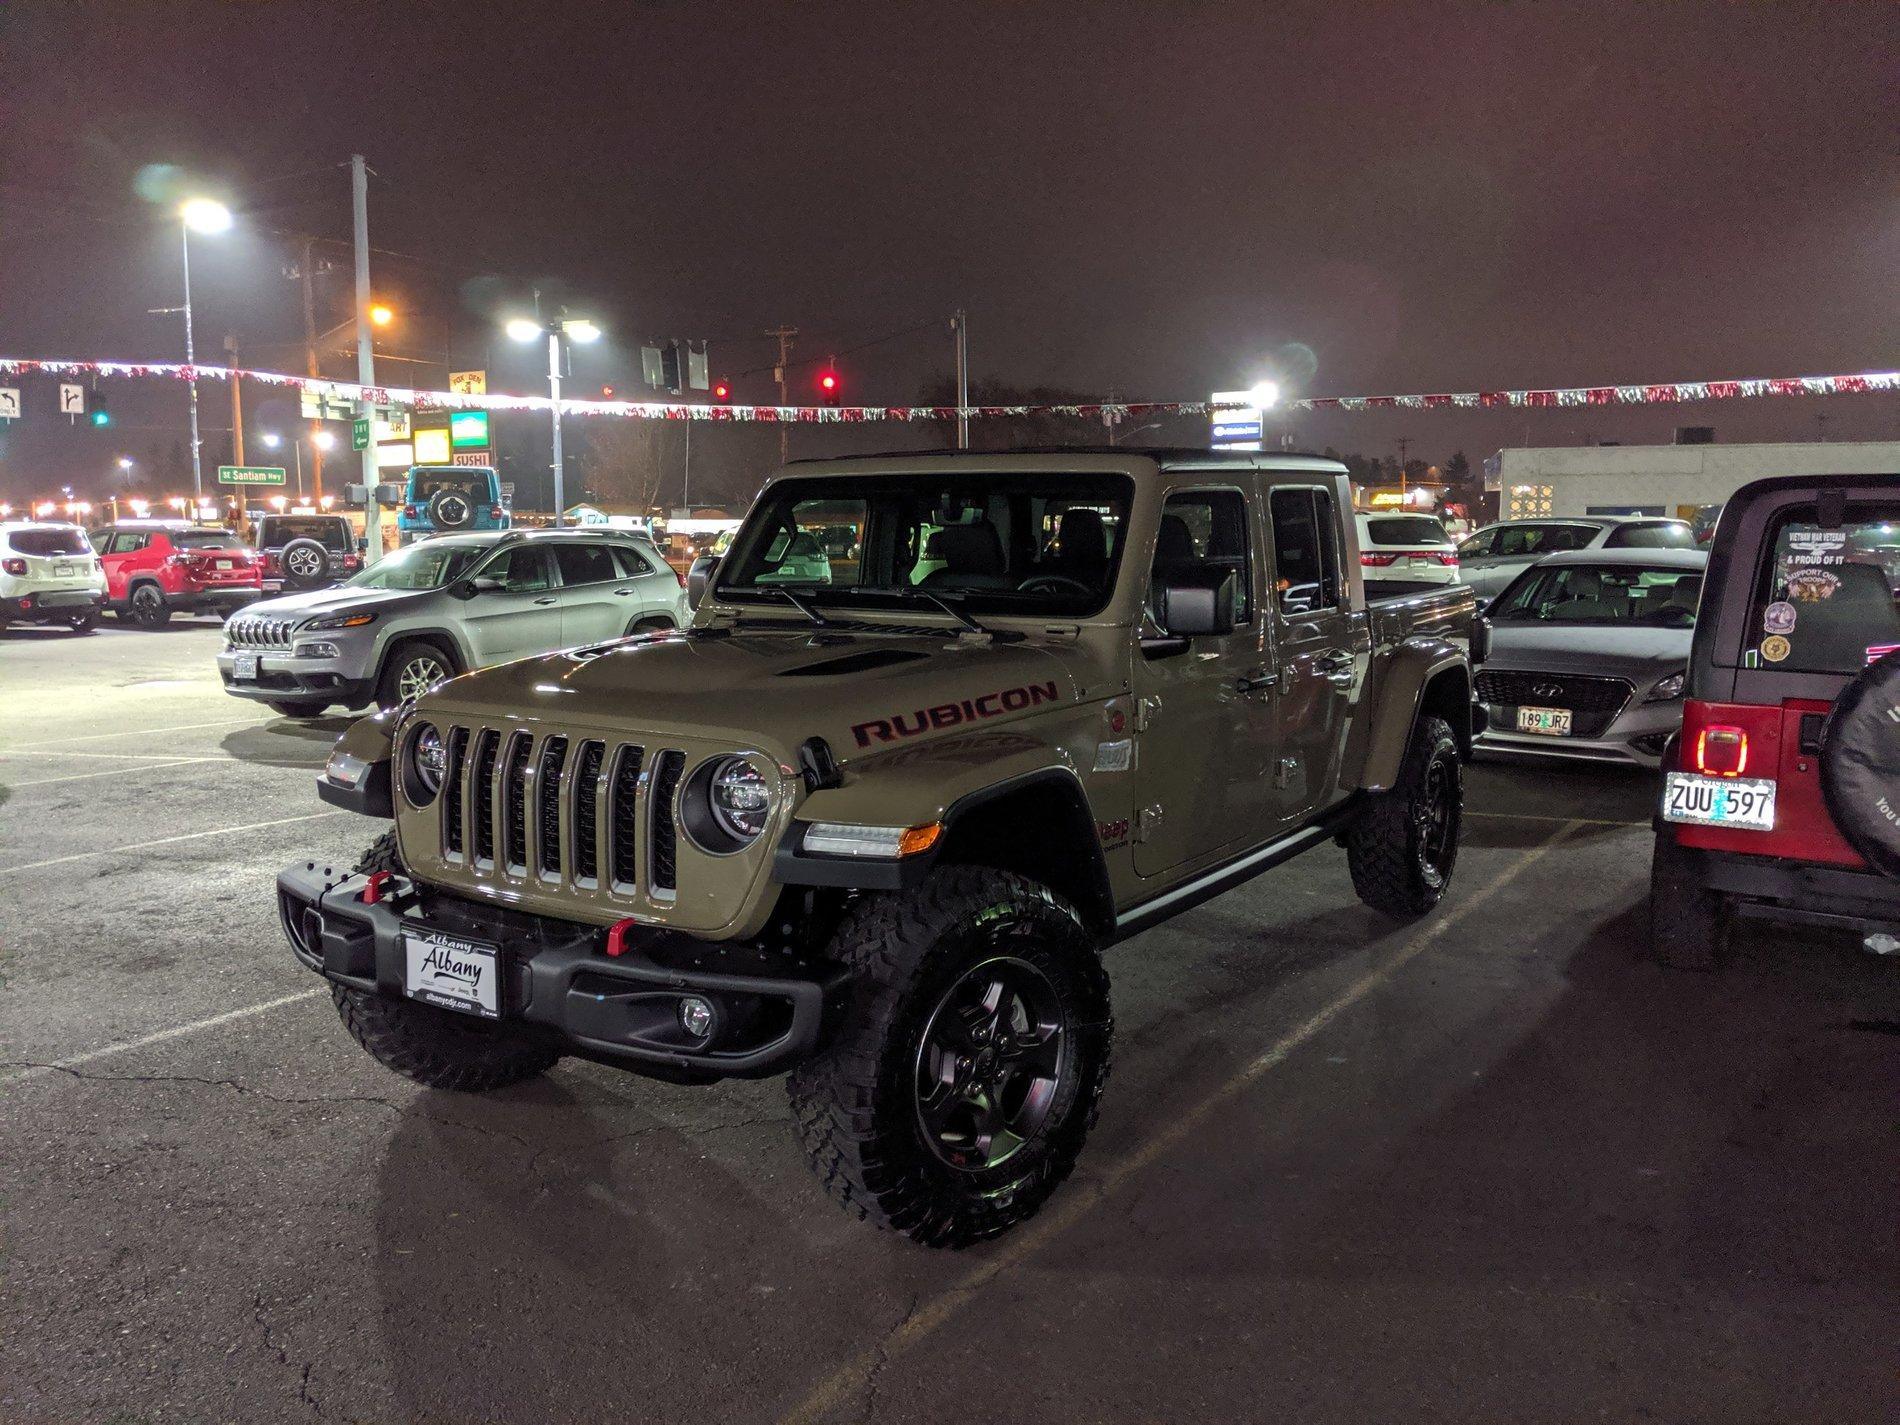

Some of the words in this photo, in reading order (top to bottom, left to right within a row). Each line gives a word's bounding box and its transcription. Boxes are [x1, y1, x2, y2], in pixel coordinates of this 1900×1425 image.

[468, 374, 482, 384] DEN
[456, 455, 487, 466] SUSHI
[223, 471, 231, 479] SE
[232, 470, 267, 480] Santiam
[268, 473, 282, 481] Hwy
[1789, 532, 1811, 541] VIETNAM
[1823, 532, 1846, 541] VETERAN
[1787, 555, 1794, 564] &
[1795, 556, 1822, 565] PROUD
[1823, 556, 1834, 565] OF
[1836, 556, 1845, 565] IT
[1786, 569, 1822, 582] SUPPORT
[1822, 571, 1839, 583] OUR
[850, 680, 1059, 748] RUBICON
[1522, 712, 1542, 727] 189
[1548, 715, 1569, 730] JRZ
[1671, 784, 1714, 812] ZUU
[1726, 789, 1769, 818] 597
[1875, 796, 1897, 821] You
[424, 934, 473, 954] Albany
[421, 947, 482, 987] Albany
